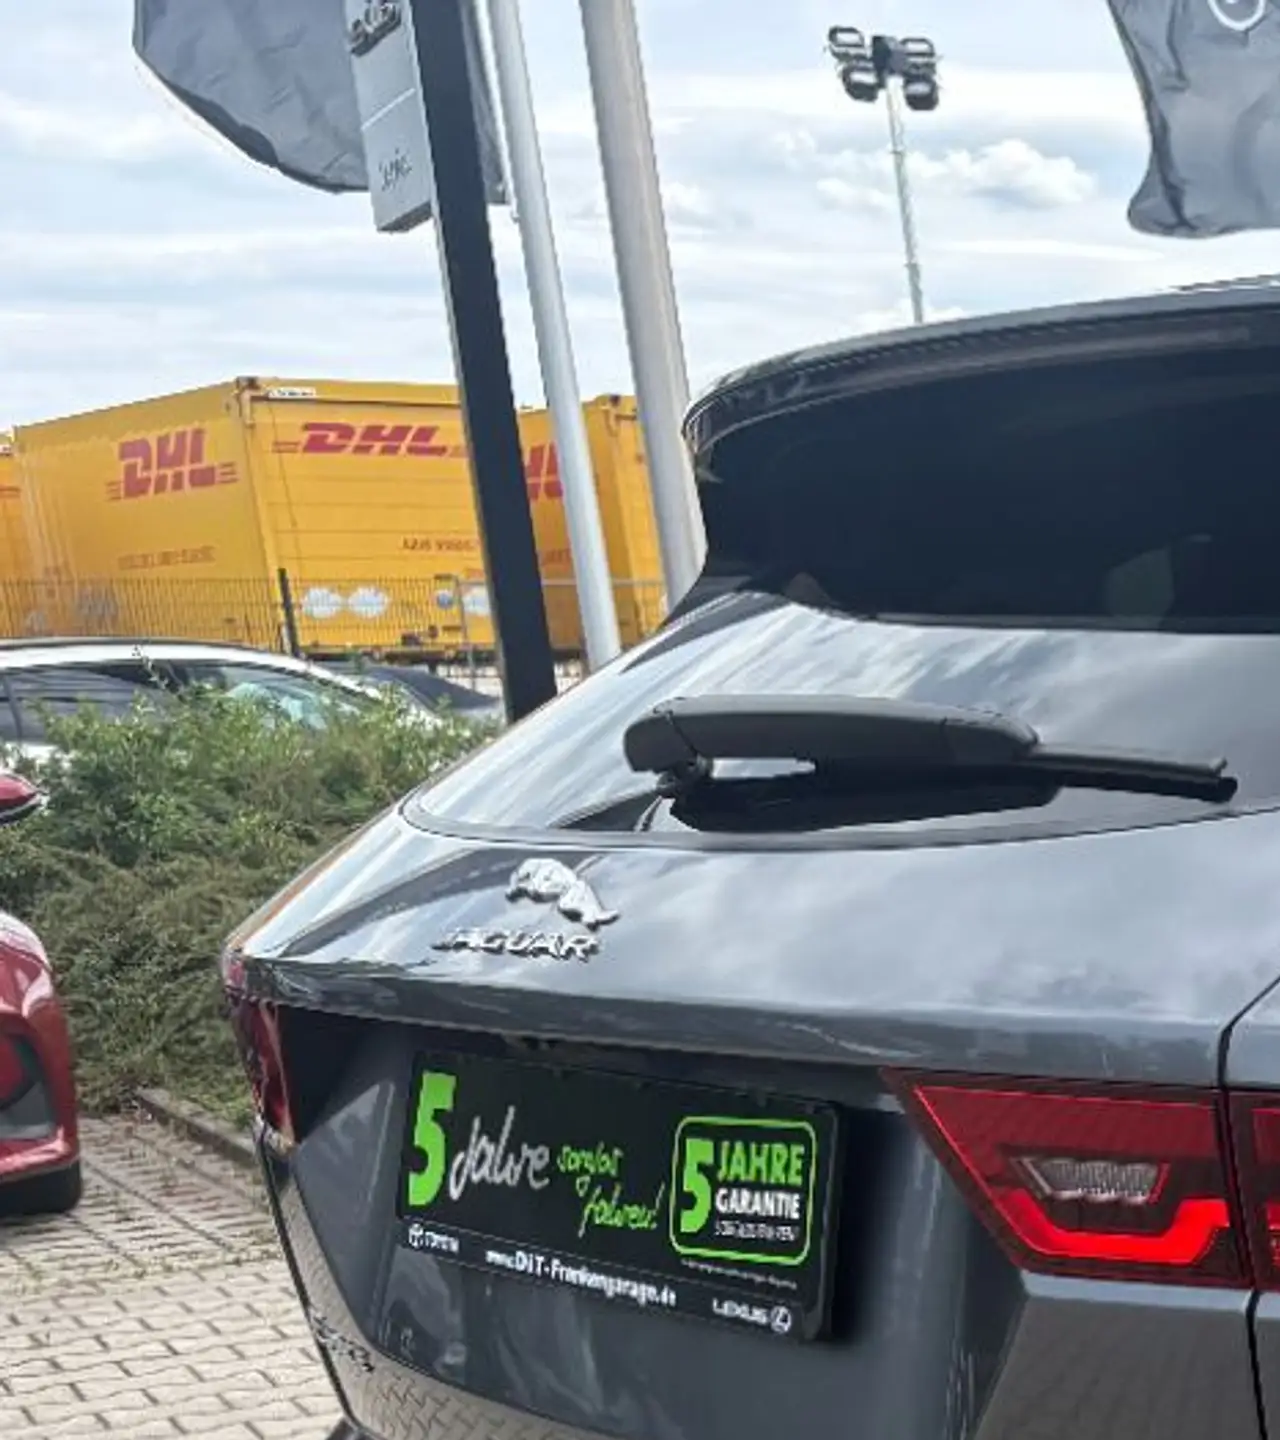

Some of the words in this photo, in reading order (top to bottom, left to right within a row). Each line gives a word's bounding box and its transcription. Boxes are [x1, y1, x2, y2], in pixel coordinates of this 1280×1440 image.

[118, 428, 216, 498] DHL
[302, 422, 448, 457] DHL
[430, 928, 602, 962] JAGUAR
[408, 1070, 457, 1206] 5
[449, 1105, 551, 1202] Jahre
[679, 1138, 715, 1233] 5
[717, 1140, 806, 1187] JAHRE
[715, 1187, 801, 1221] GARANTIE
